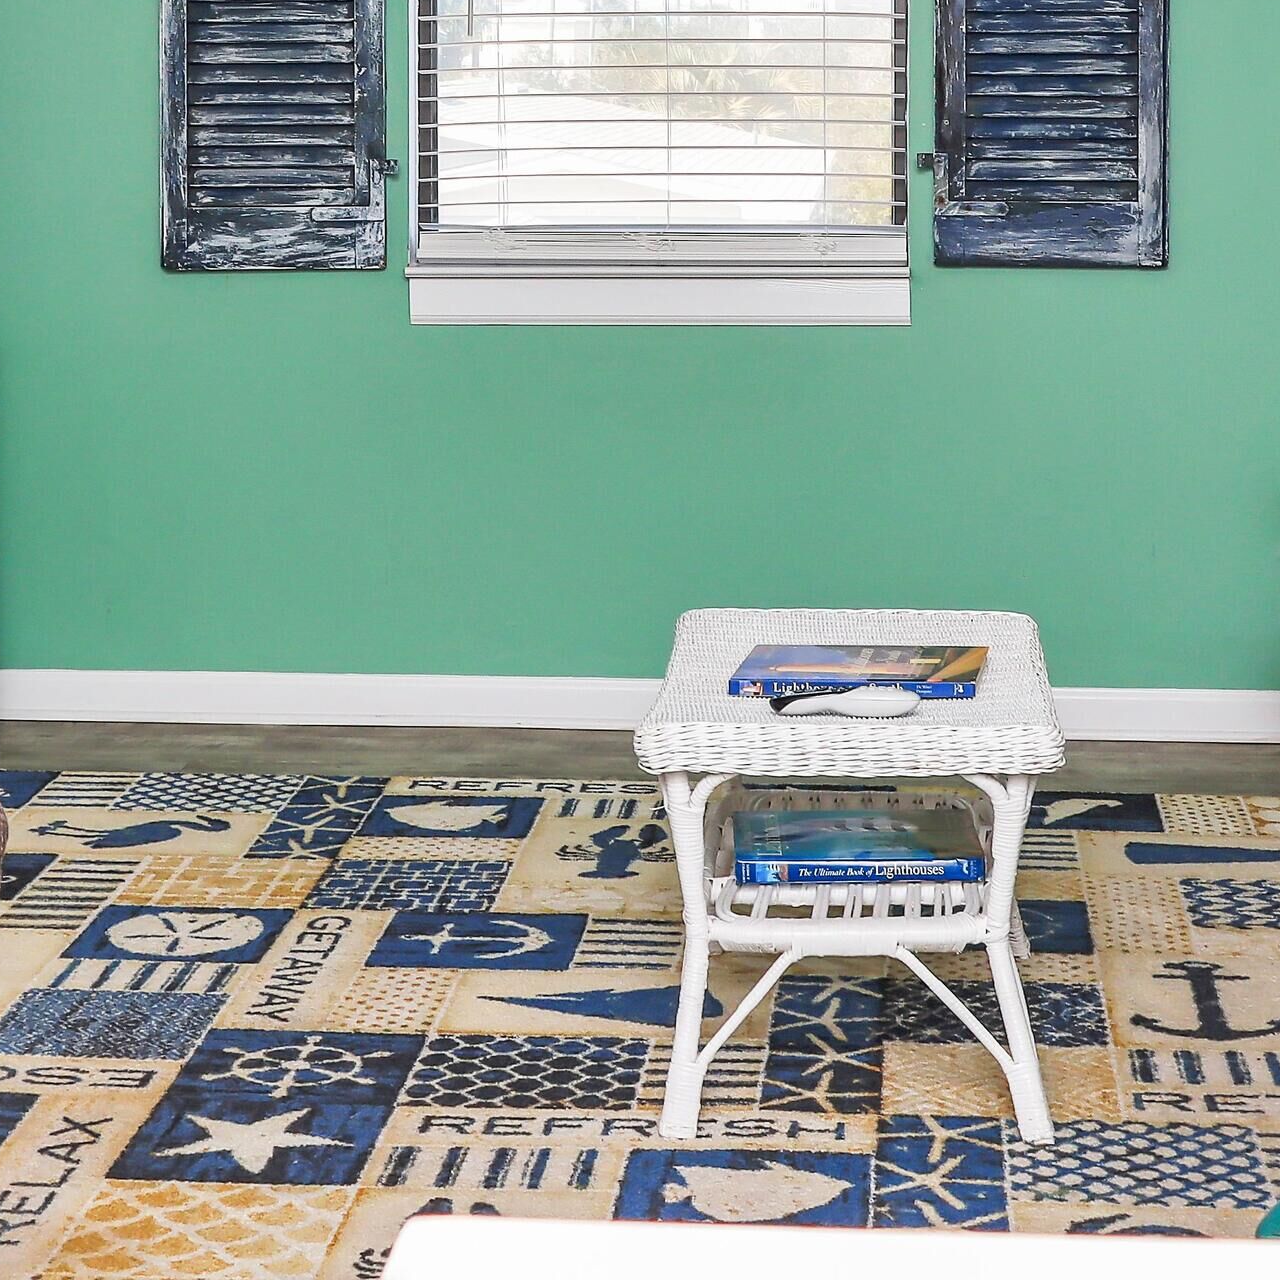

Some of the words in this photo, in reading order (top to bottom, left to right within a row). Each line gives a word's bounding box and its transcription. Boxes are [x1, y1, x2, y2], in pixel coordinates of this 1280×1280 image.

[799, 867, 813, 877] The
[813, 867, 846, 877] Ultimate
[846, 867, 865, 877] Book
[865, 866, 875, 878] of
[875, 863, 945, 879] Lighthouses
[245, 915, 353, 1023] GETAWAY
